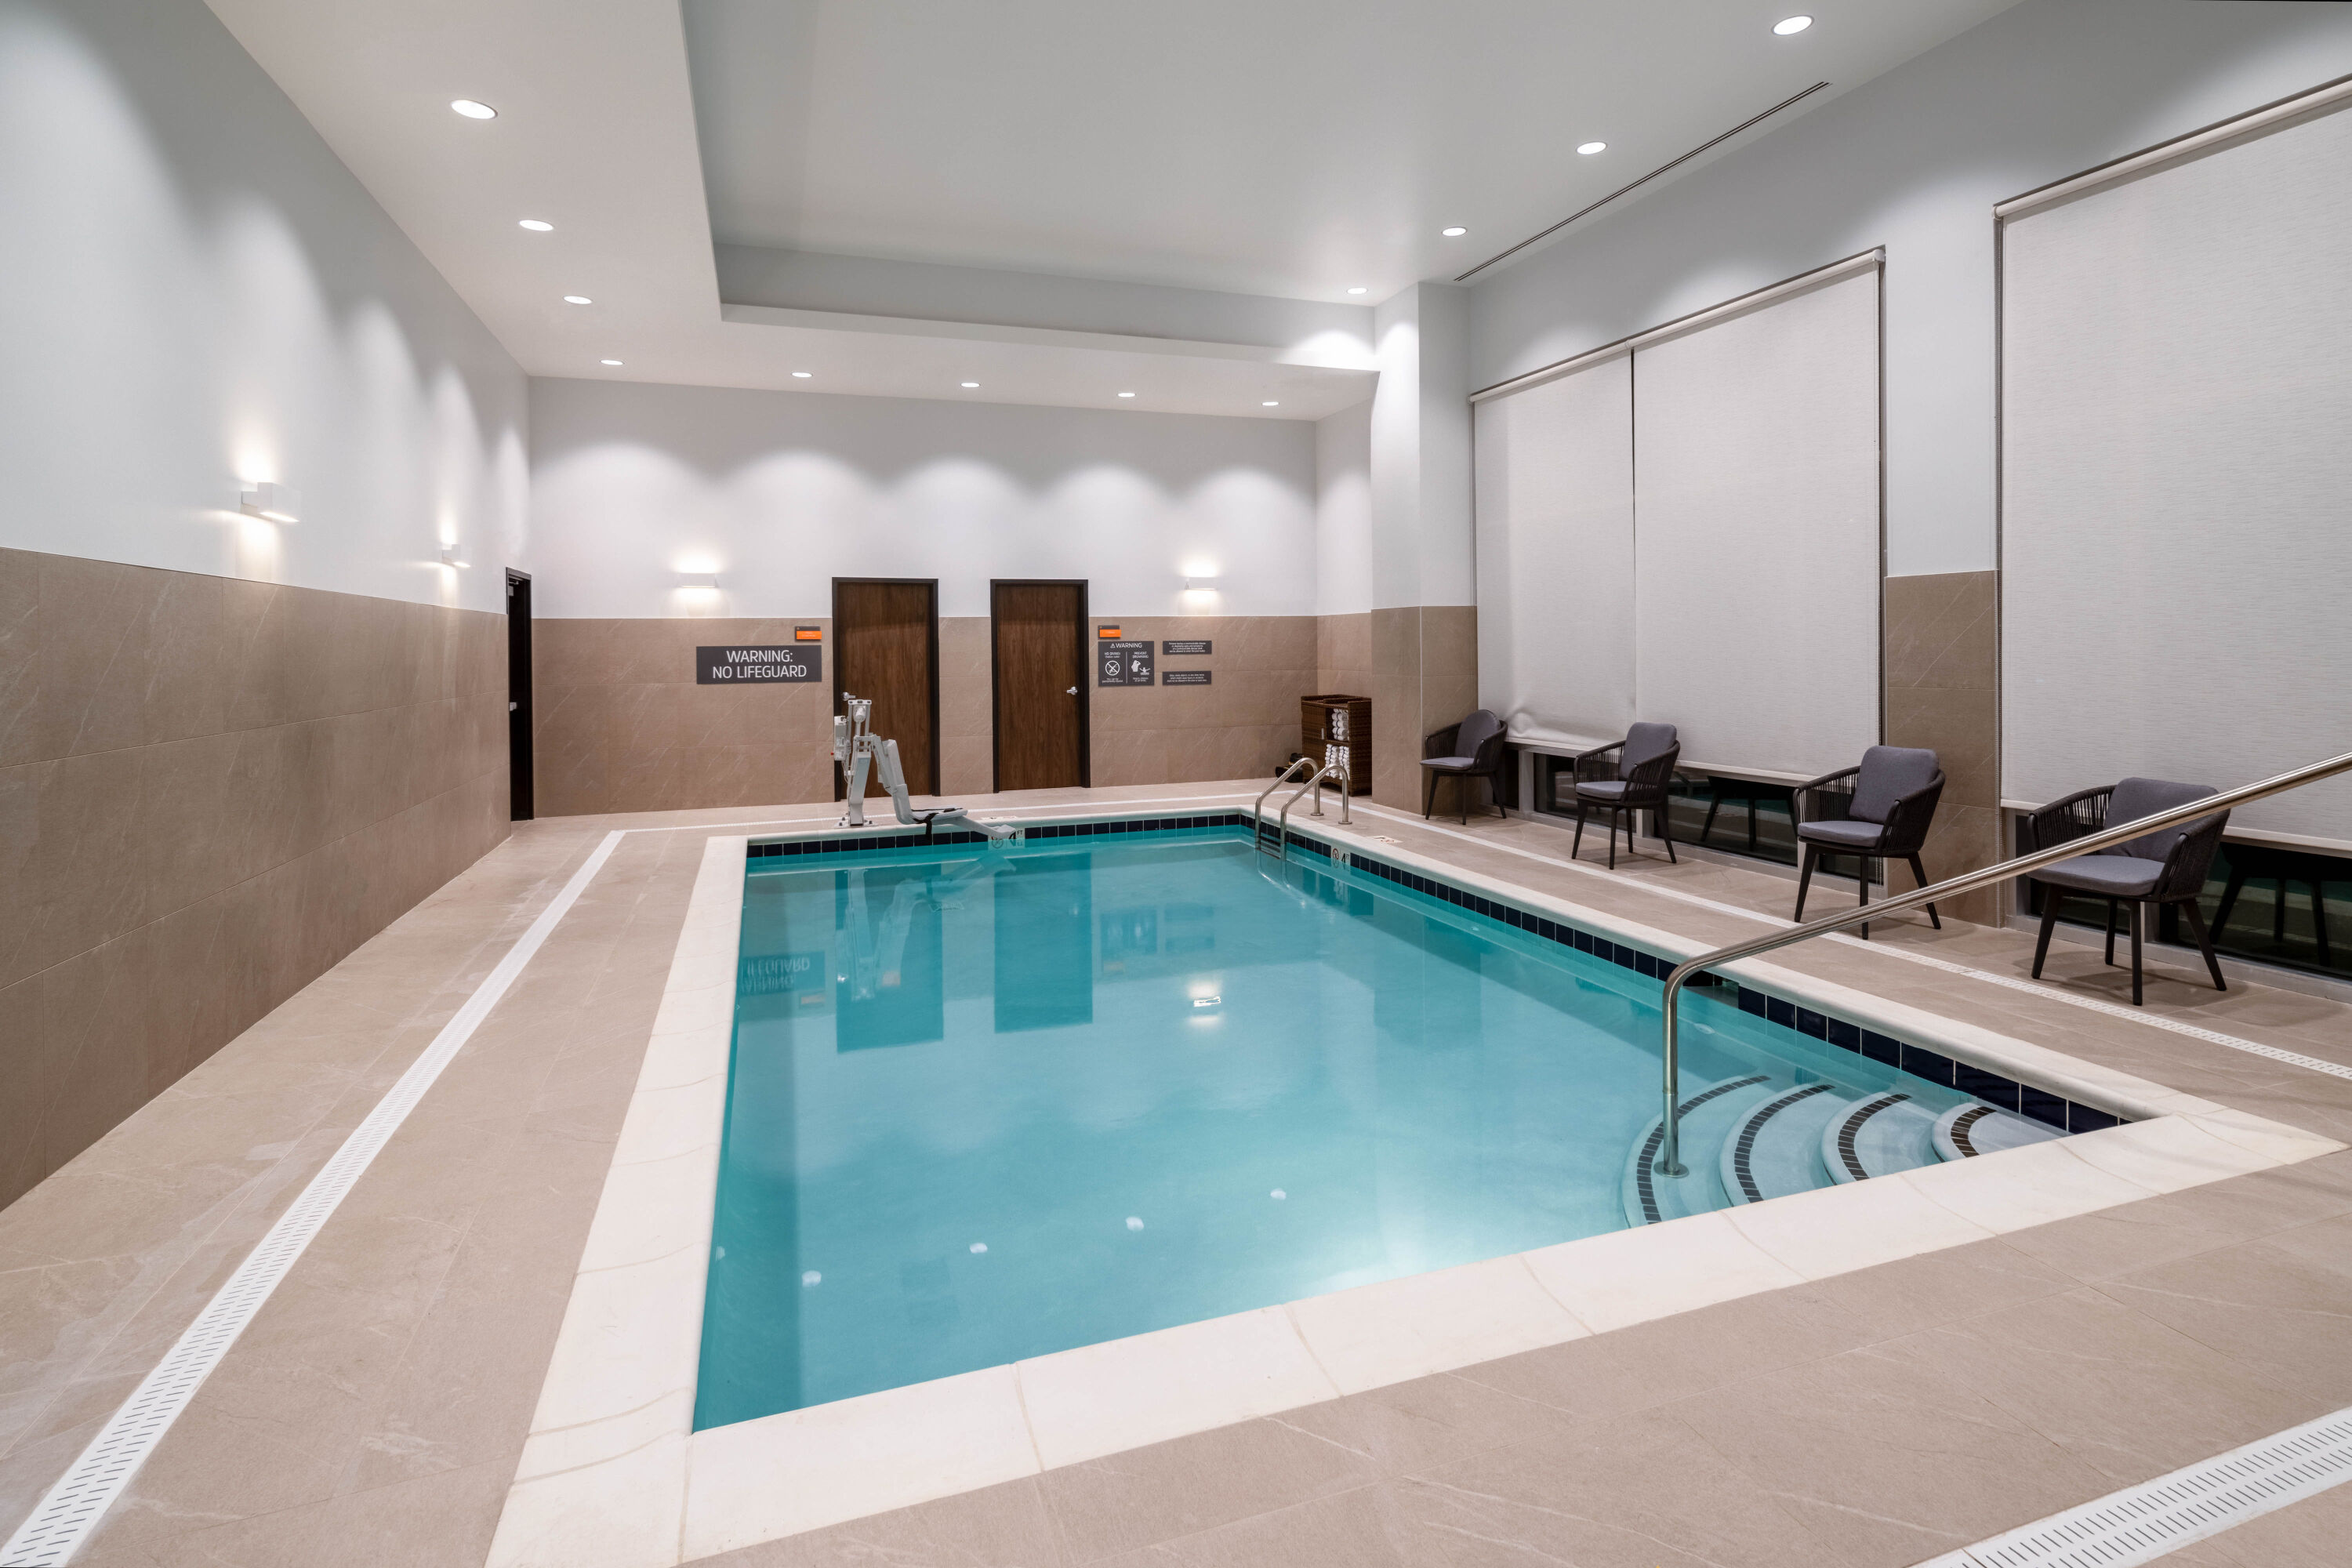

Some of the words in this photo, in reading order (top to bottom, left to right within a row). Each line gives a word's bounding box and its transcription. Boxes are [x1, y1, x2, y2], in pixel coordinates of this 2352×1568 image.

[726, 650, 793, 663] WARNING:
[712, 666, 733, 679] NO
[737, 664, 808, 678] LIFEGUARD
